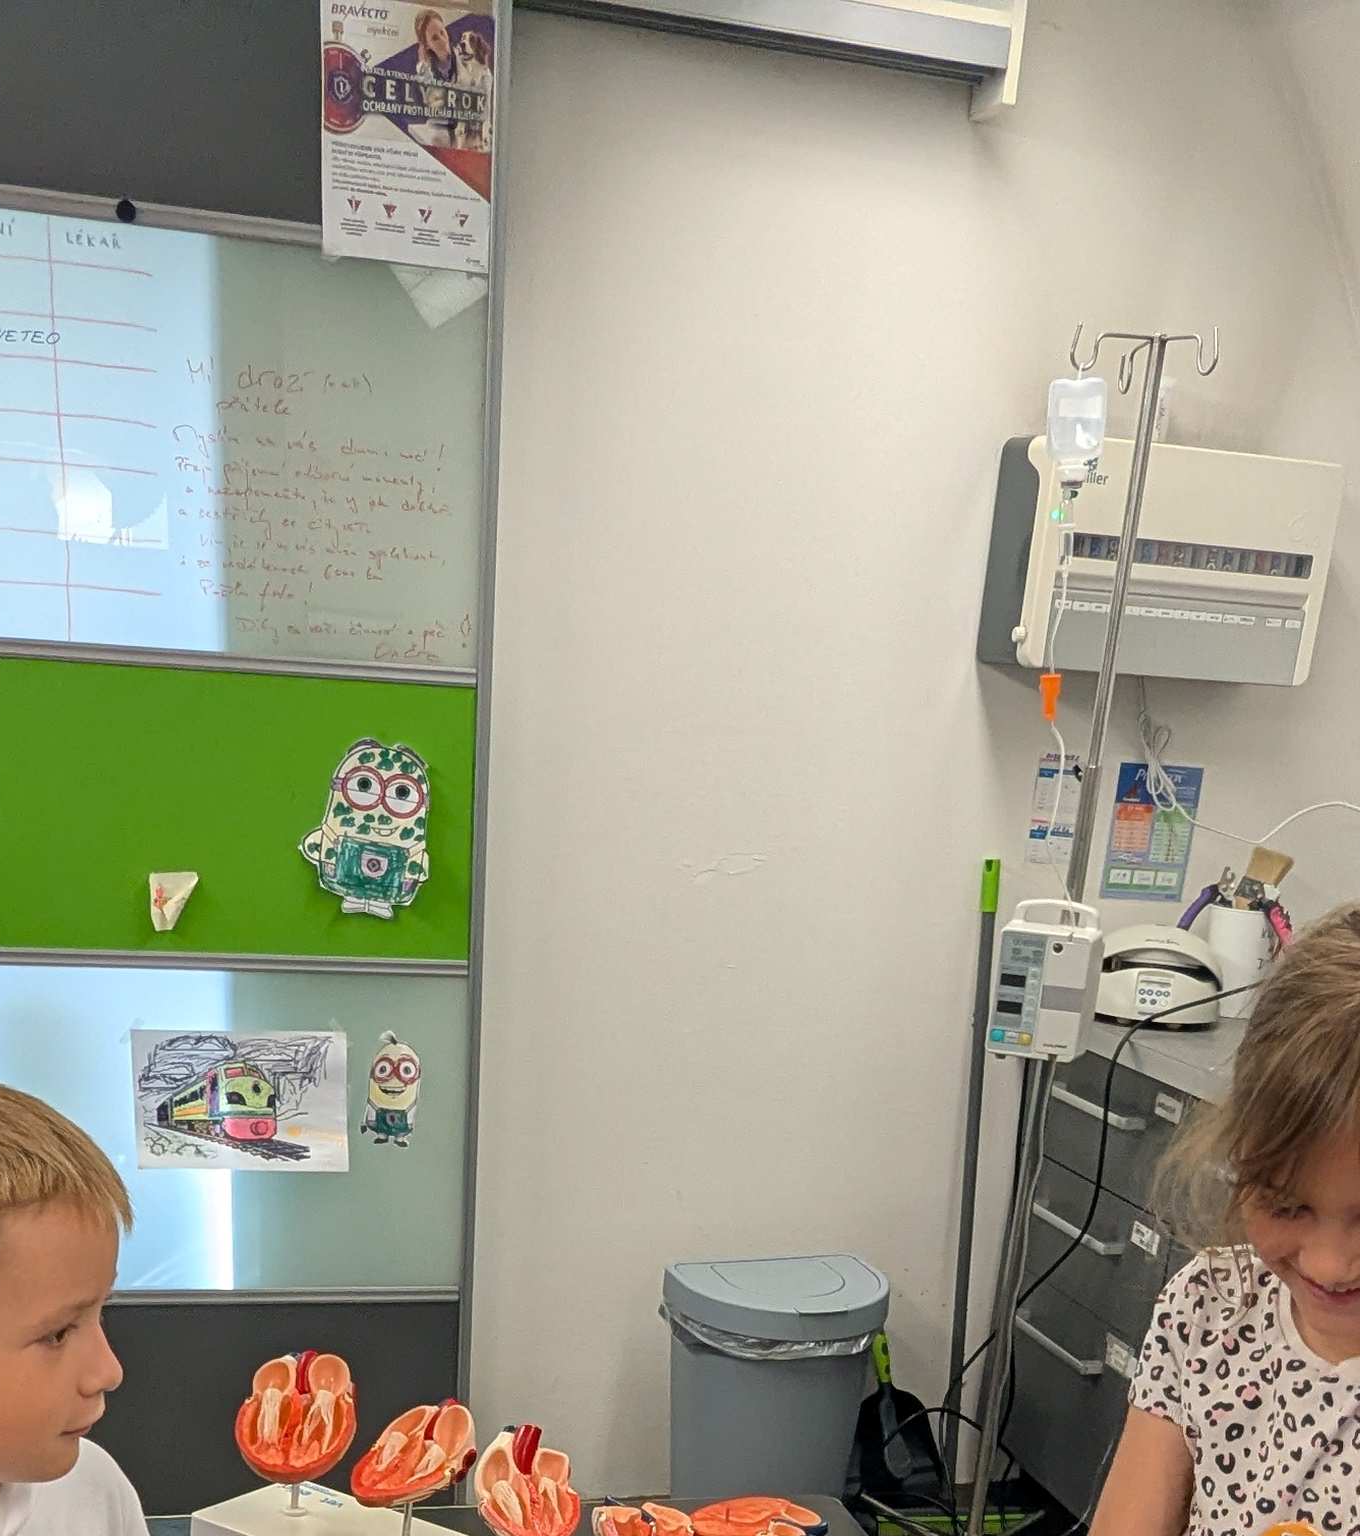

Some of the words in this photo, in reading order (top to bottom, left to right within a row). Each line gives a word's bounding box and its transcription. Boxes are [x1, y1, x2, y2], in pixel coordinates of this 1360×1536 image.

[331, 2, 388, 20] BRAVECTO
[447, 90, 485, 111] ROK
[65, 228, 121, 249] LÉKAŘ
[1085, 471, 1109, 485] iller
